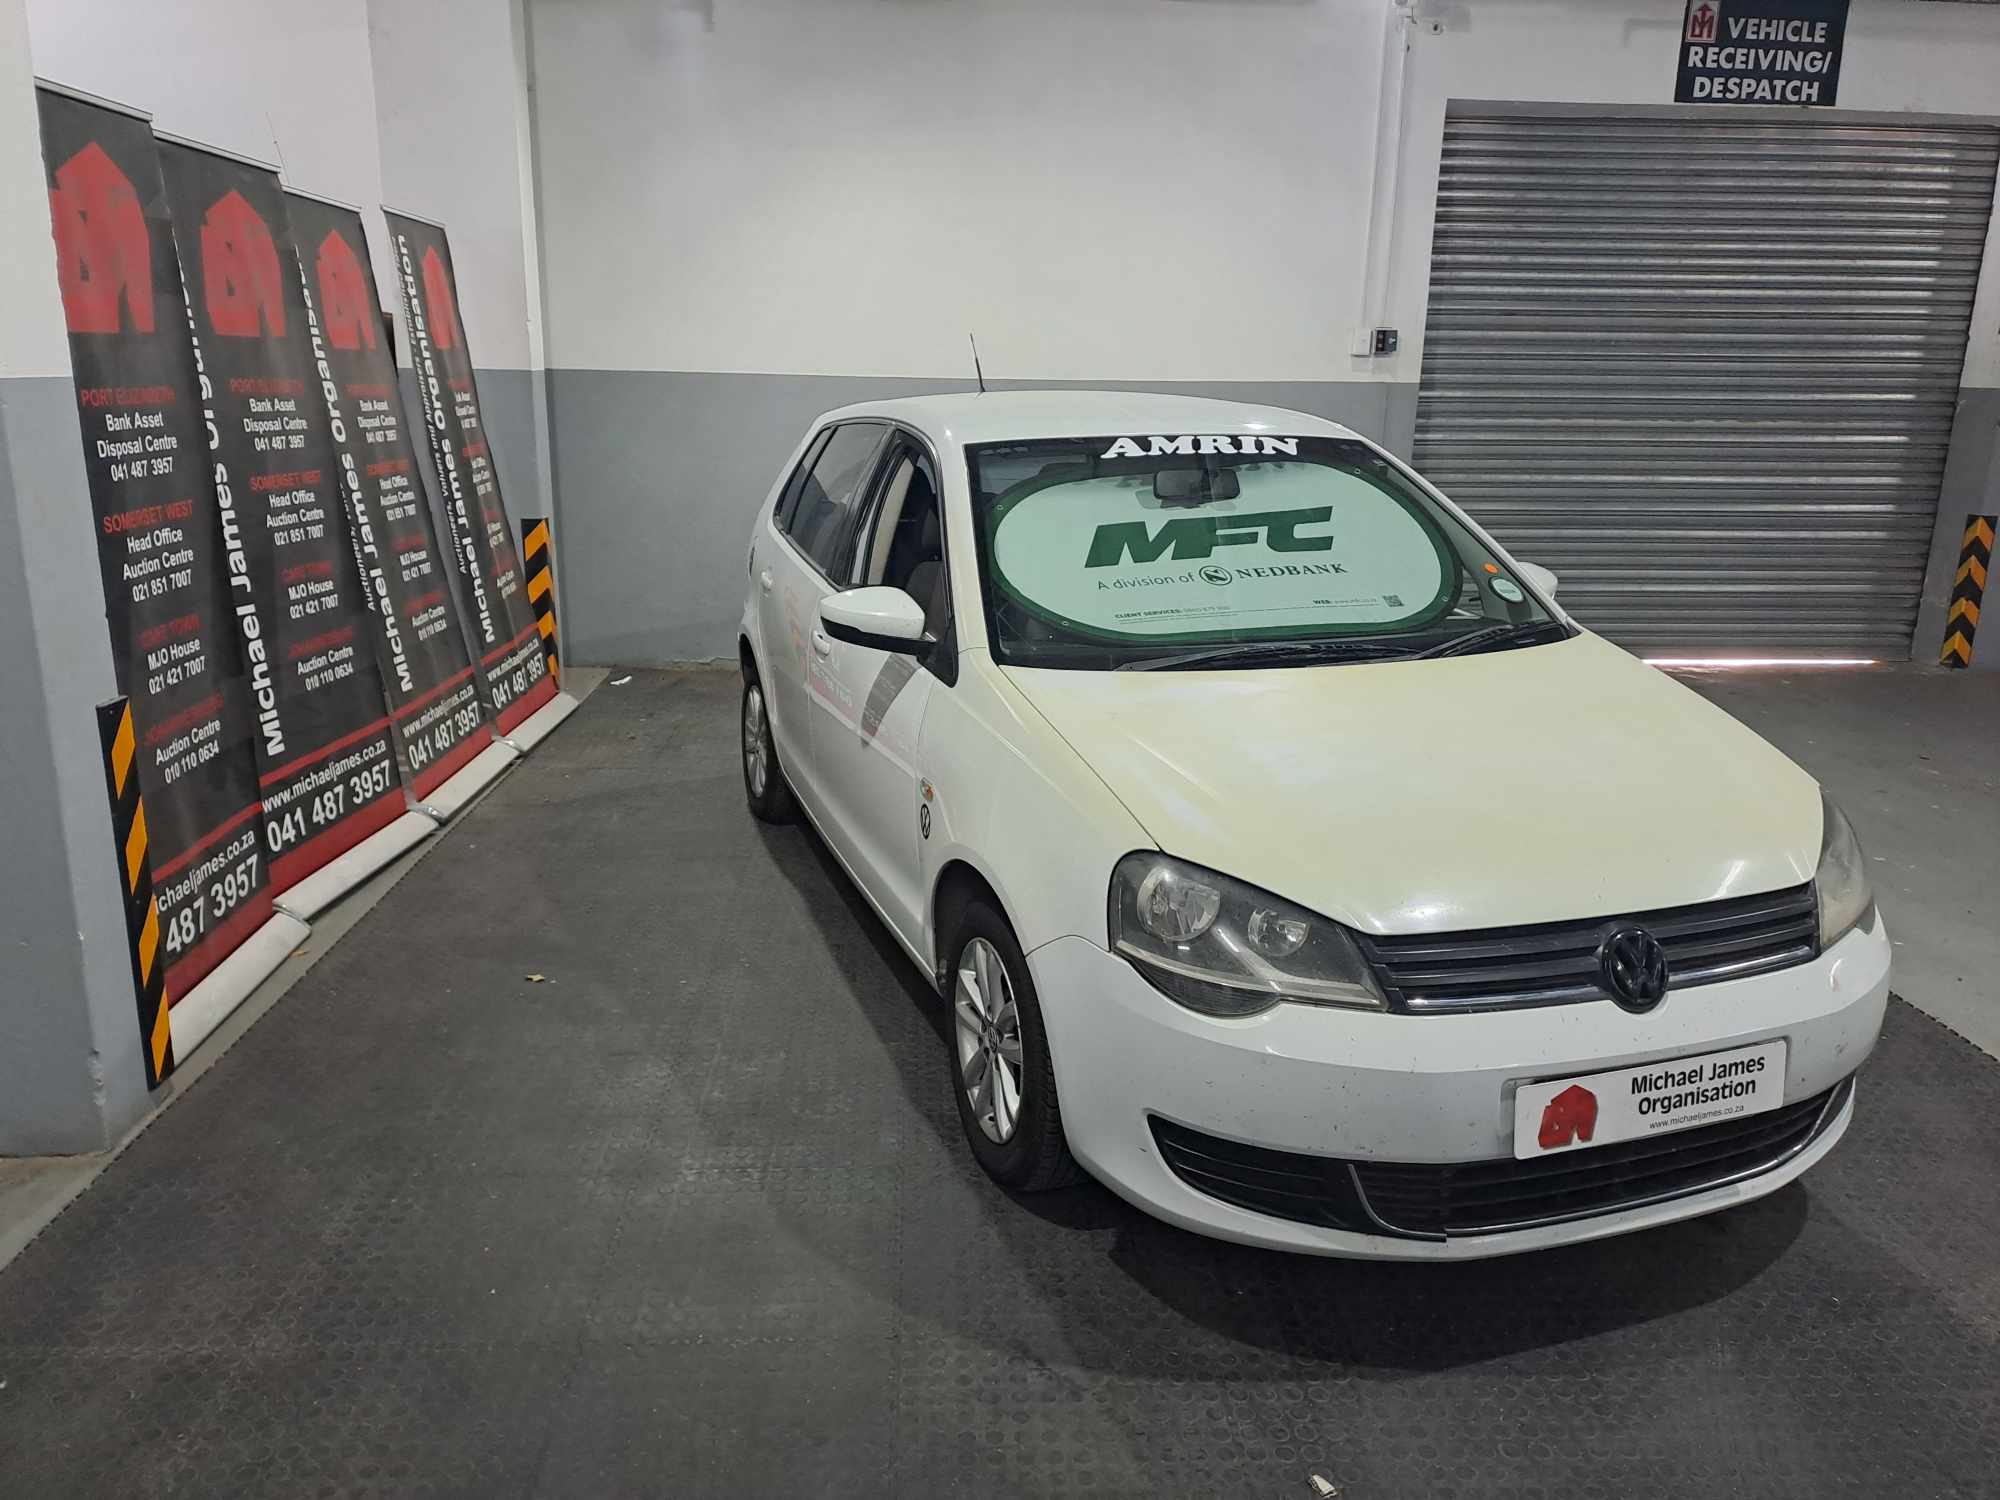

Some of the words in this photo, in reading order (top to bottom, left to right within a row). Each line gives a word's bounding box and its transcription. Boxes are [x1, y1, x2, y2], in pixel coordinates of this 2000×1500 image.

[1728, 17, 1828, 43] VEHICLE
[1687, 46, 1832, 73] RECEIVING/
[1693, 77, 1819, 102] DESPATCH
[398, 234, 446, 430] Organisation
[106, 413, 132, 432] Bank
[134, 411, 163, 429] Asset
[249, 398, 273, 413] Bank
[274, 398, 296, 412] Asset
[243, 418, 282, 434] Disposal
[283, 416, 308, 430] Centre
[428, 425, 438, 449] and
[97, 439, 143, 460] Disposal
[145, 434, 178, 451] Centre
[254, 437, 270, 452] 041
[271, 436, 287, 450] 487
[1101, 436, 1299, 459] AMRIN
[111, 463, 129, 482] 041
[130, 460, 148, 478] 487
[151, 456, 173, 476] 3957
[442, 439, 469, 529] James
[269, 493, 291, 509] Head
[292, 490, 316, 505] Office
[342, 453, 379, 559] James
[214, 462, 251, 593] James
[266, 512, 299, 529] Auction
[299, 508, 325, 523] Centre
[127, 534, 152, 554] Head
[153, 528, 183, 546] Office
[274, 530, 289, 547] 021
[290, 528, 306, 543] 851
[307, 524, 325, 540] 7007
[1084, 506, 1334, 568] MFC
[123, 557, 160, 580] Auction
[162, 548, 194, 567] Centre
[1097, 580, 1110, 591] A
[1113, 575, 1177, 590] division
[1179, 572, 1196, 586] of
[1236, 563, 1348, 579] NEDBANK
[133, 583, 150, 602] 021
[150, 576, 169, 594] 851
[170, 569, 192, 589] 7007
[288, 583, 307, 601] MJO
[308, 579, 334, 597] House
[462, 537, 495, 644] Michael
[289, 604, 304, 620] 021
[305, 599, 320, 615] 421
[369, 568, 414, 693] Michael
[147, 648, 169, 671] MJO
[170, 638, 201, 659] House
[297, 655, 327, 676] Auction
[328, 645, 353, 664] Centre
[149, 677, 165, 695] 021
[166, 665, 183, 686] 421
[184, 656, 205, 679] 7007
[236, 603, 286, 756] Michael
[305, 674, 319, 691] 010
[320, 668, 334, 686] 110
[335, 662, 354, 681] 0634
[492, 680, 512, 709] 041
[526, 652, 545, 683] 3957
[155, 736, 190, 766] Auction
[191, 718, 221, 744] Centre
[408, 734, 434, 771] 041
[434, 719, 455, 753] 487
[454, 701, 480, 736] 3957
[165, 763, 180, 784] 010
[181, 753, 197, 773] 110
[199, 739, 220, 764] 0634
[262, 739, 386, 814] www.michaeljames.co.za
[266, 806, 306, 853] 041
[312, 783, 345, 826] 487
[350, 759, 391, 804] 3957
[157, 831, 255, 914] chaeljames.co.za
[165, 897, 205, 955] 487
[210, 853, 258, 917] 3957
[1631, 1065, 1704, 1095] Michael
[1709, 1056, 1766, 1082] James
[1638, 1079, 1757, 1115] Organisation
